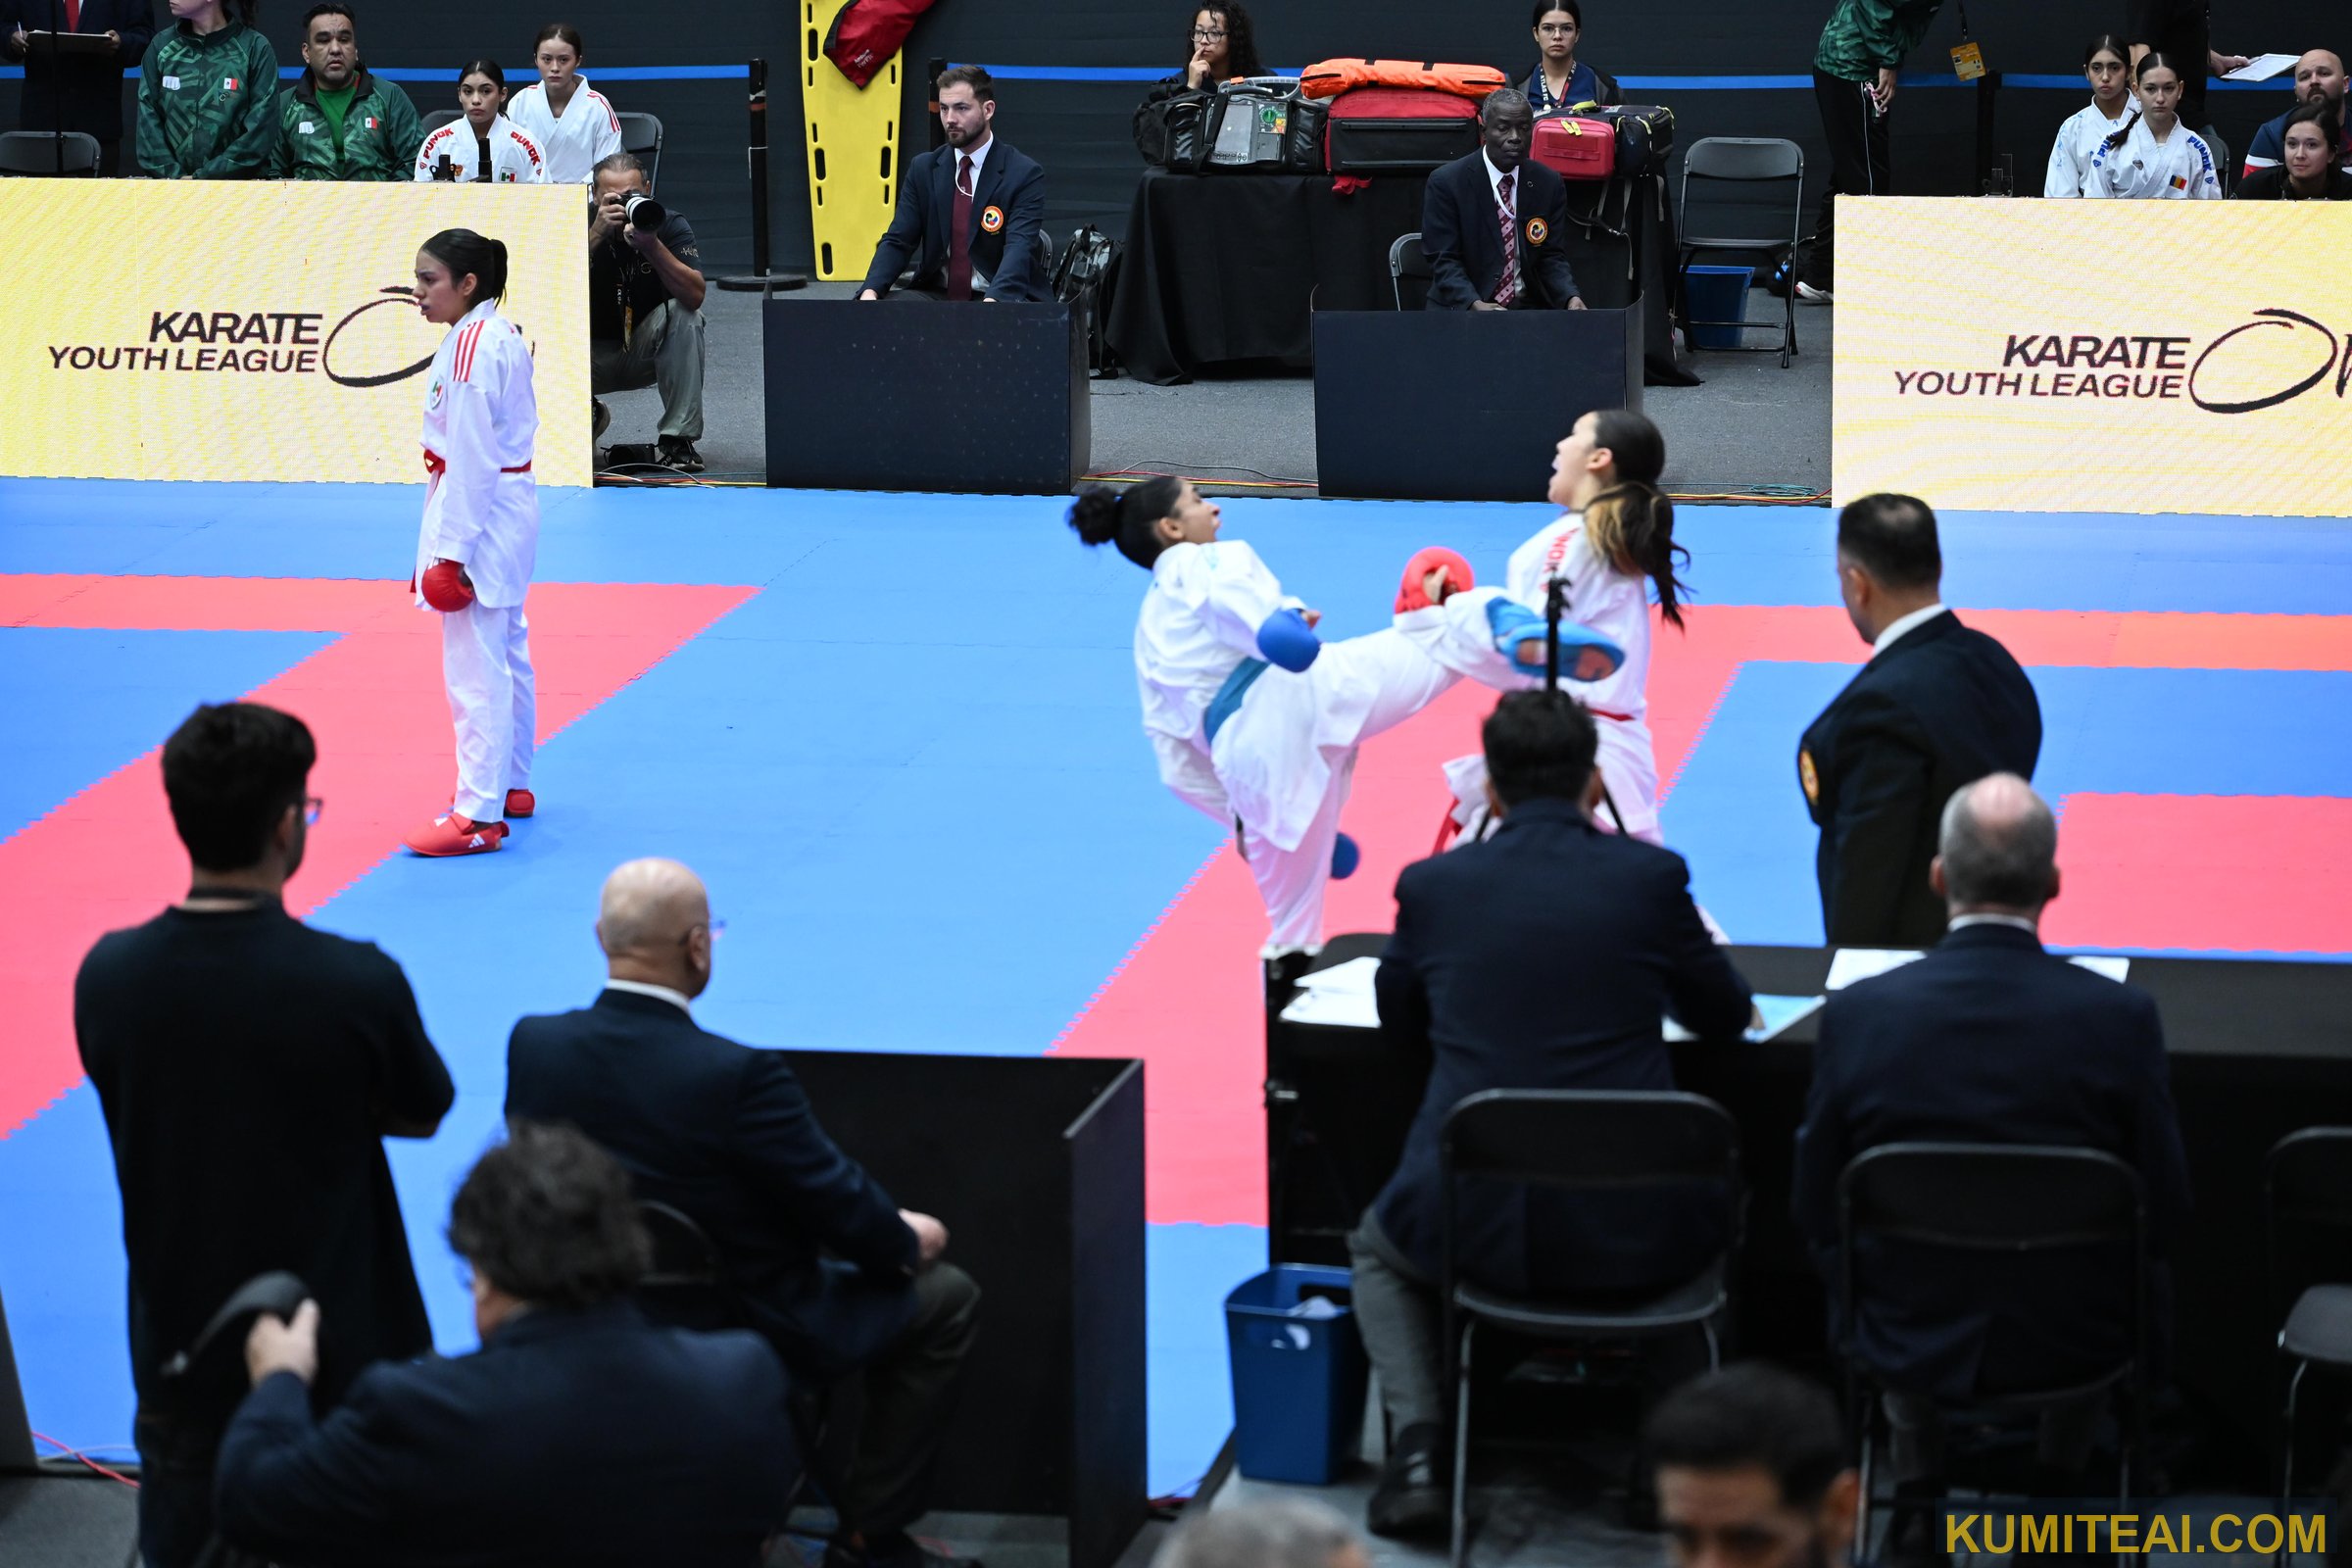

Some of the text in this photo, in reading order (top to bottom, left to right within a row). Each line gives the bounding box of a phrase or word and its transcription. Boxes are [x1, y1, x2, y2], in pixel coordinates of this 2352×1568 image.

[149, 312, 323, 344] KARATE
[48, 346, 318, 372] YOUTH LEAGUE
[2002, 335, 2191, 369] KARATE
[1893, 370, 2181, 399] YOUTH LEAGUE
